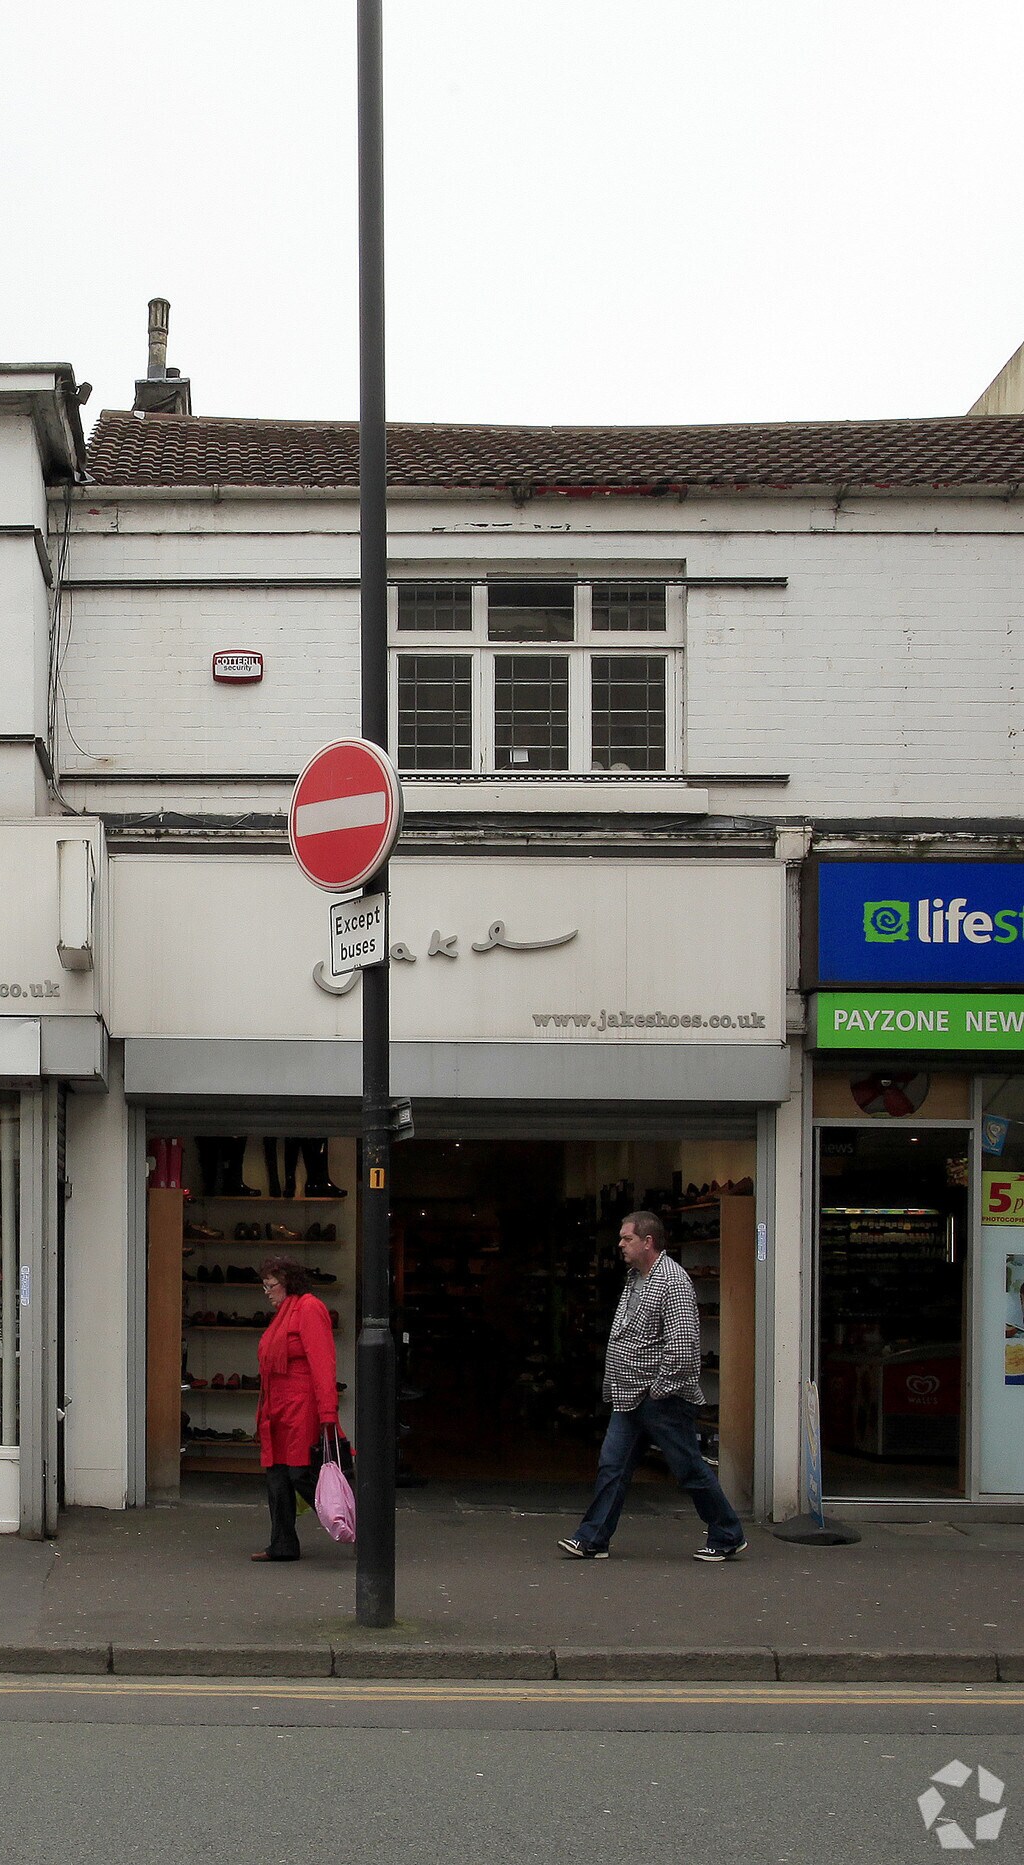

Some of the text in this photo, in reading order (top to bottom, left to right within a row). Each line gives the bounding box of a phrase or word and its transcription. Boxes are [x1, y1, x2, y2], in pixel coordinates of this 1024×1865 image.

[216, 656, 260, 666] COTTERILL
[335, 906, 380, 935] Except
[917, 897, 1024, 944] lifes
[340, 938, 376, 961] buses
[532, 1009, 766, 1032] www.jakeshoes.co.uk
[833, 1009, 950, 1032] PAYZONE
[374, 1170, 381, 1188] 1
